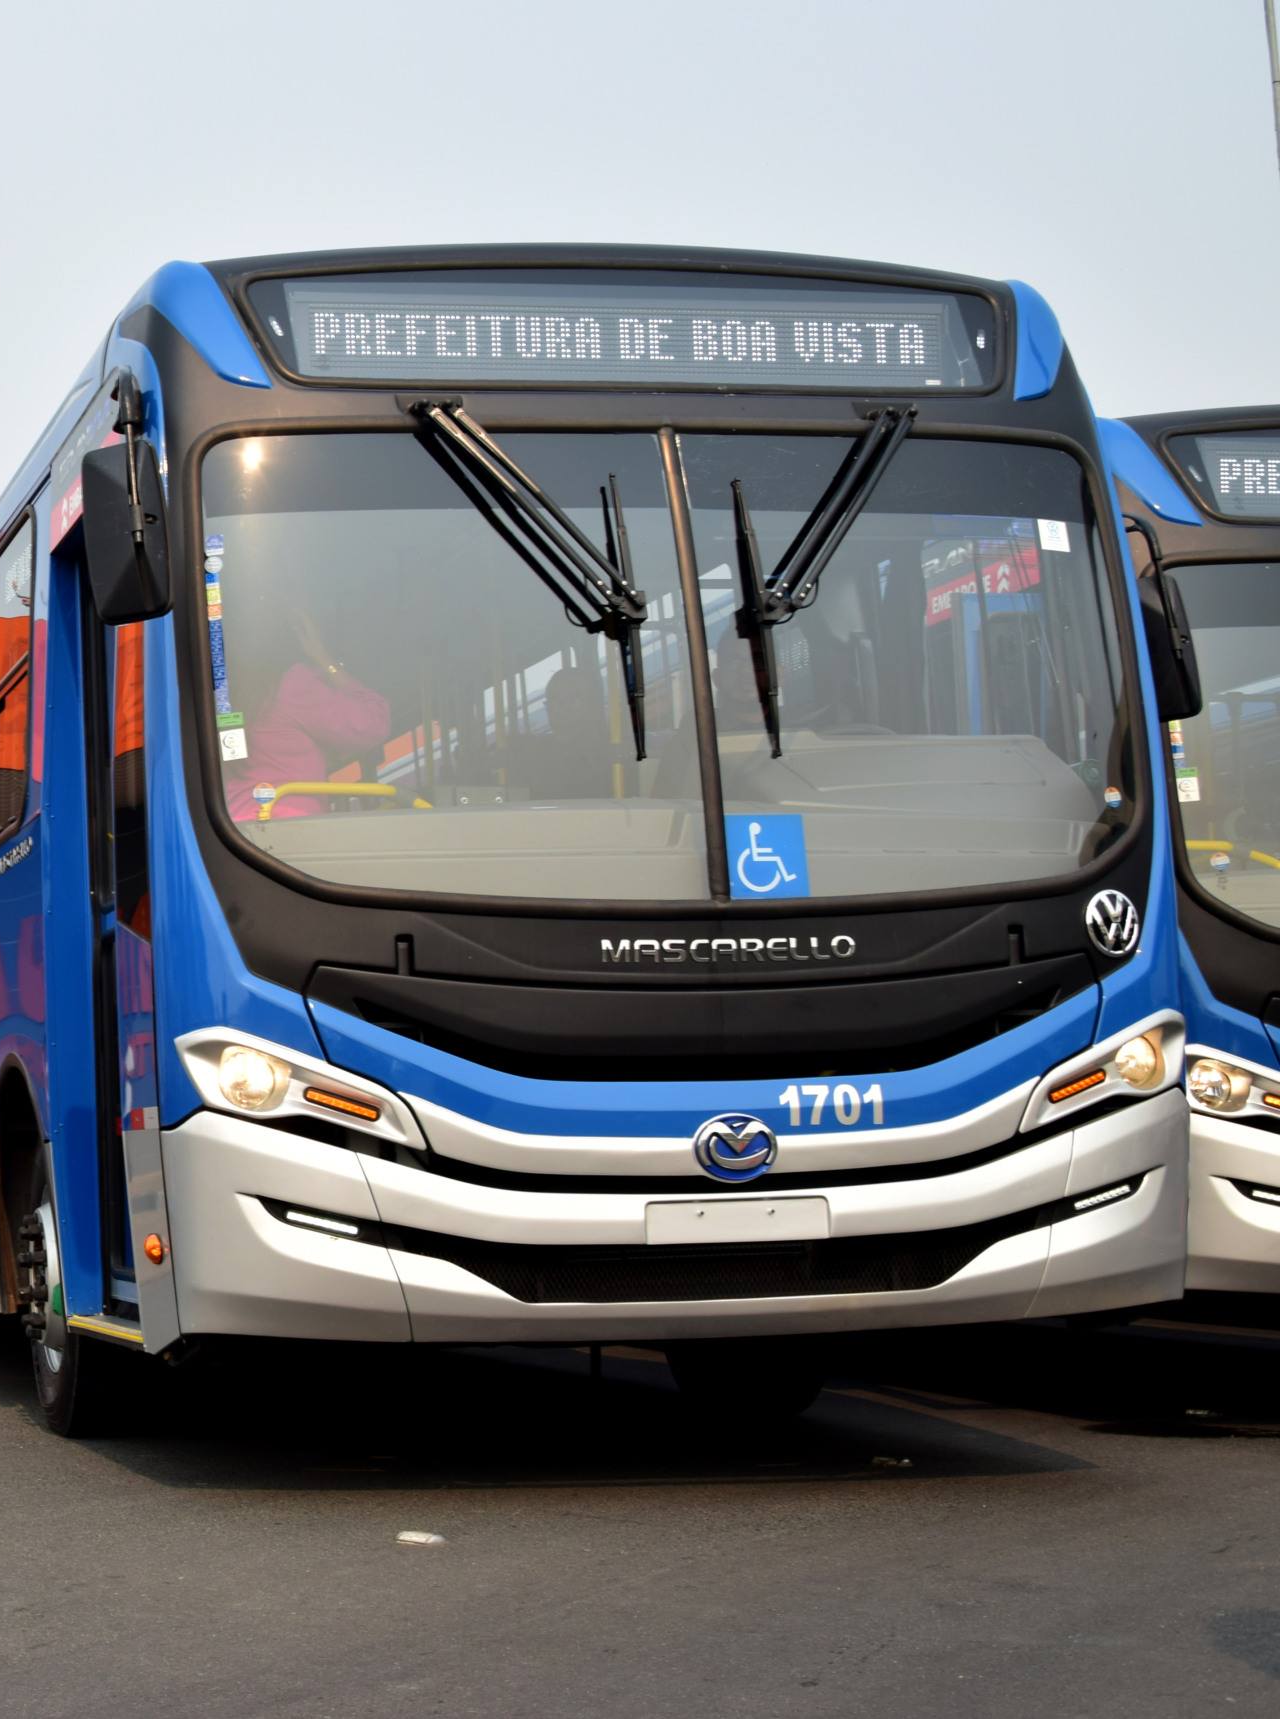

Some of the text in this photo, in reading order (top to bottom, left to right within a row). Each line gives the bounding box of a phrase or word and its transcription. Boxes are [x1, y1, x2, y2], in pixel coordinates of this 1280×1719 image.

[314, 312, 925, 365] PREFEITURA DE BOA VISTA
[600, 935, 856, 963] MASCARELLO
[778, 1083, 884, 1126] 1701
